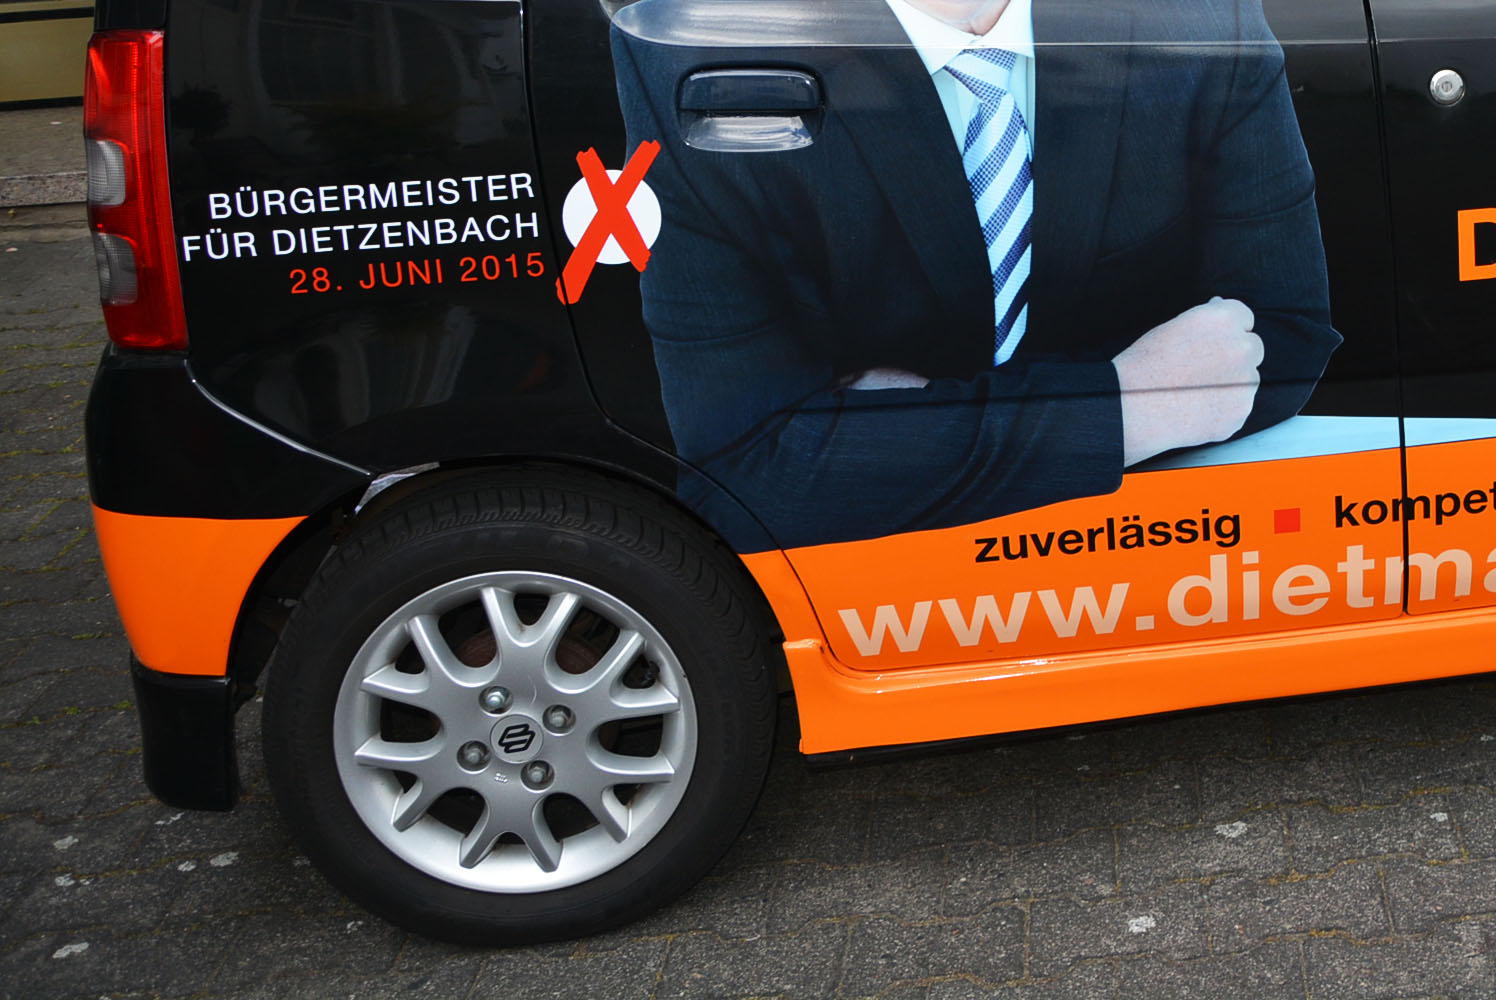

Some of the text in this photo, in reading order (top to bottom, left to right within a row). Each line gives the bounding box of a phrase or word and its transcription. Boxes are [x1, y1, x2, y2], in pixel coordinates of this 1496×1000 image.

[208, 172, 535, 220] BÜRGERMEISTER
[182, 212, 540, 262] FÜR DIETZENBACH
[289, 252, 545, 294] 28. JUNI 2015
[975, 508, 1241, 563] zuverlässig
